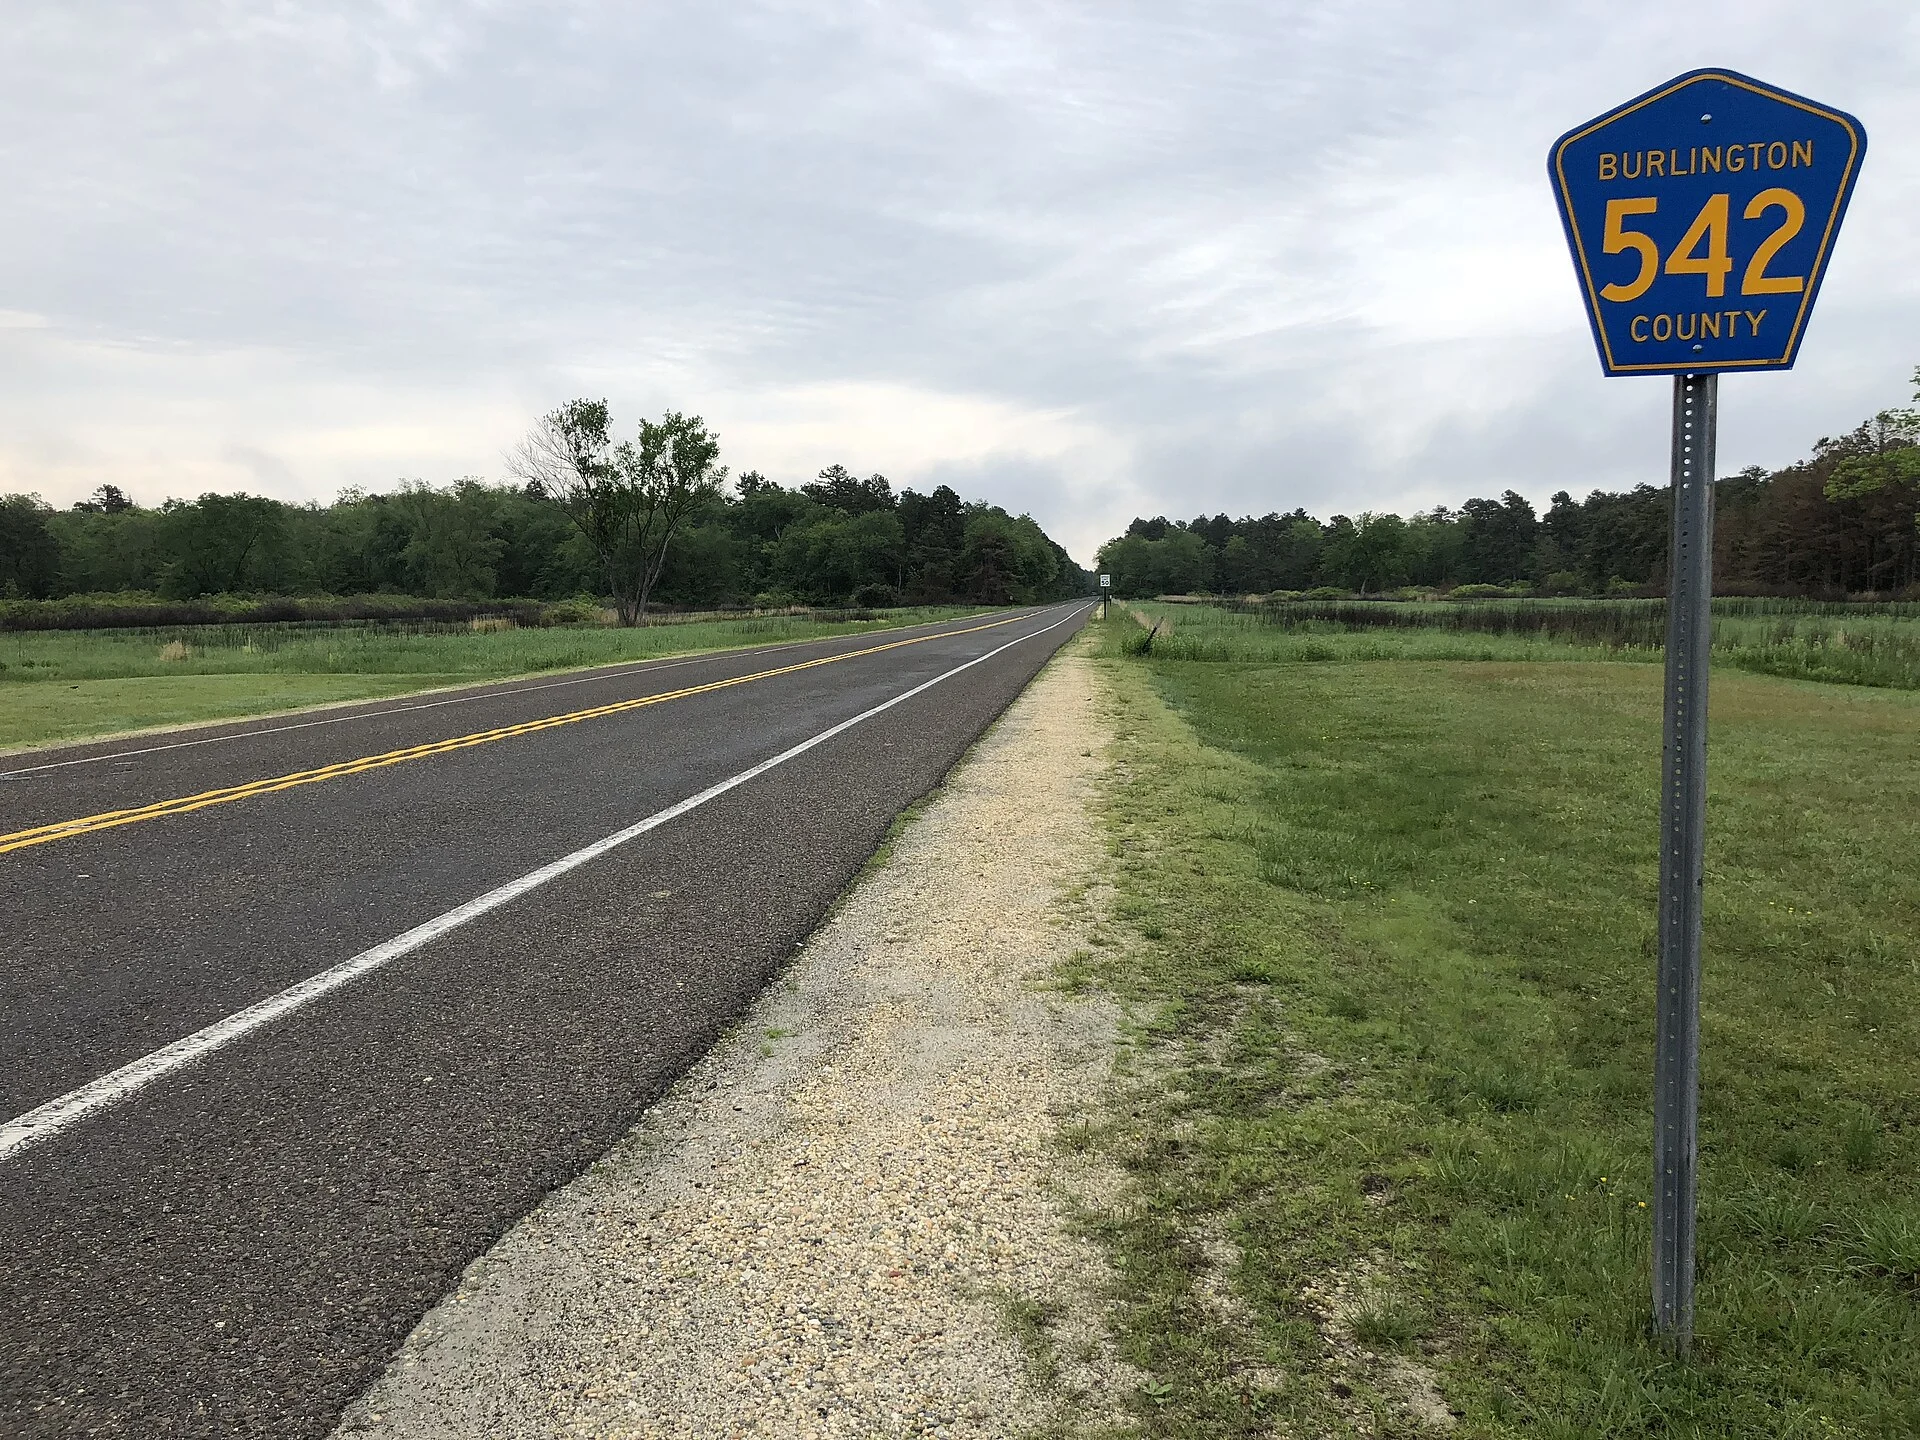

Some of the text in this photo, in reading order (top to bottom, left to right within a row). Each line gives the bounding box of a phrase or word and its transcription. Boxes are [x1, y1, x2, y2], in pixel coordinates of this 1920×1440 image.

[1599, 141, 1812, 180] BURLINGTON
[1600, 188, 1805, 302] 542
[1631, 311, 1766, 342] COUNTY
